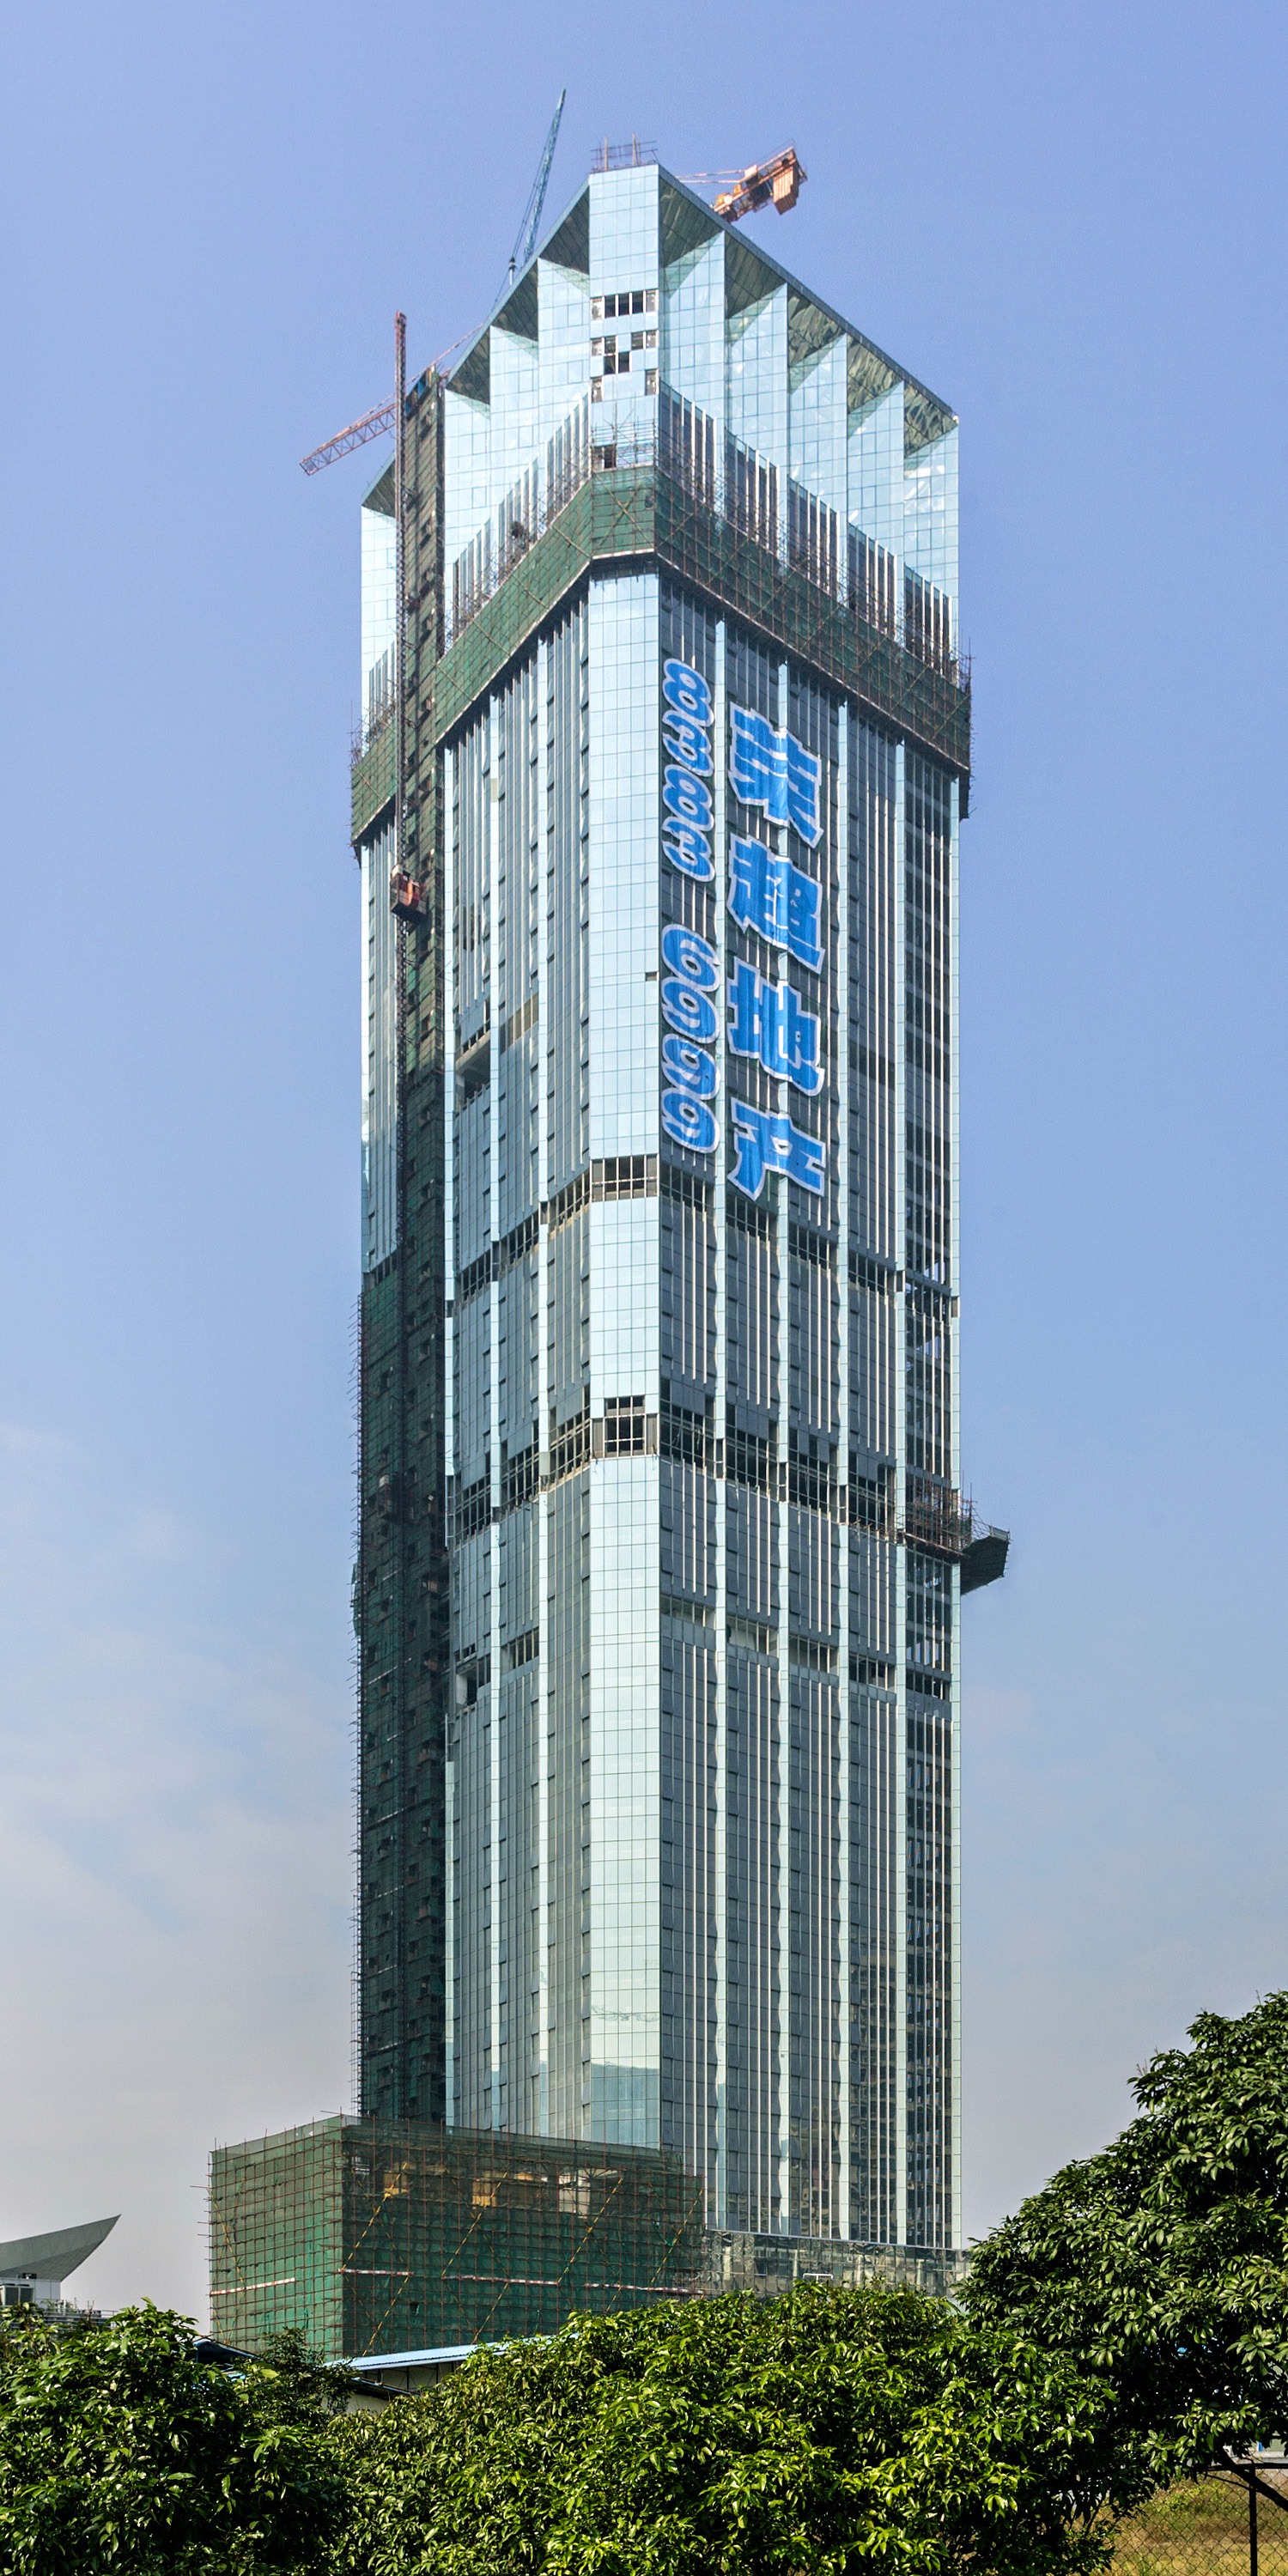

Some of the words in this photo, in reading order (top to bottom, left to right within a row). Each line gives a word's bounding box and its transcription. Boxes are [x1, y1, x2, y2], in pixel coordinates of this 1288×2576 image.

[662, 658, 715, 883] 8383
[661, 923, 720, 1153] 6999
[726, 701, 826, 1201] 荣超地产
